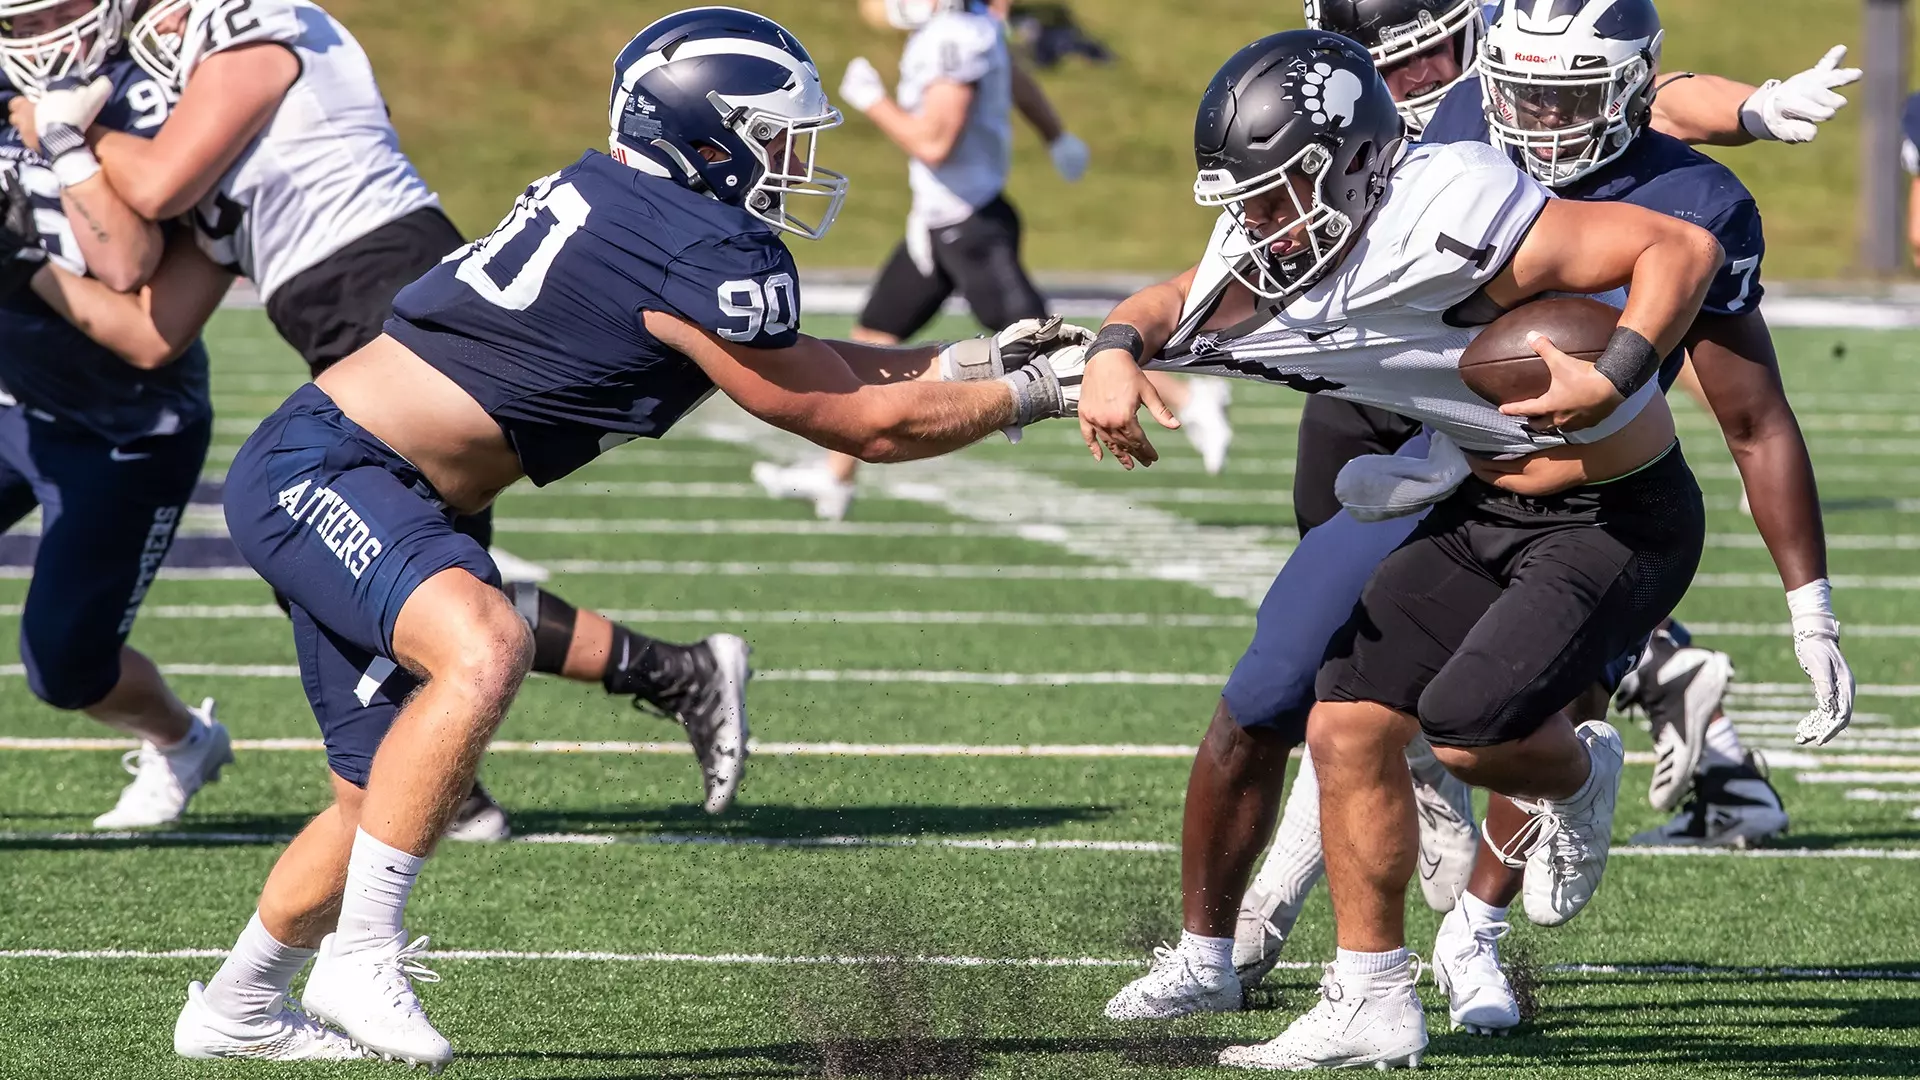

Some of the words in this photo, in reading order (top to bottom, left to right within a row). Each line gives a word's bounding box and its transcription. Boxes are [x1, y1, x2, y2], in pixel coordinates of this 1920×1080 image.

[1392, 24, 1419, 38] BOWDOIN
[1435, 231, 1498, 272] 1
[717, 272, 798, 342] 90
[1726, 254, 1759, 312] 7
